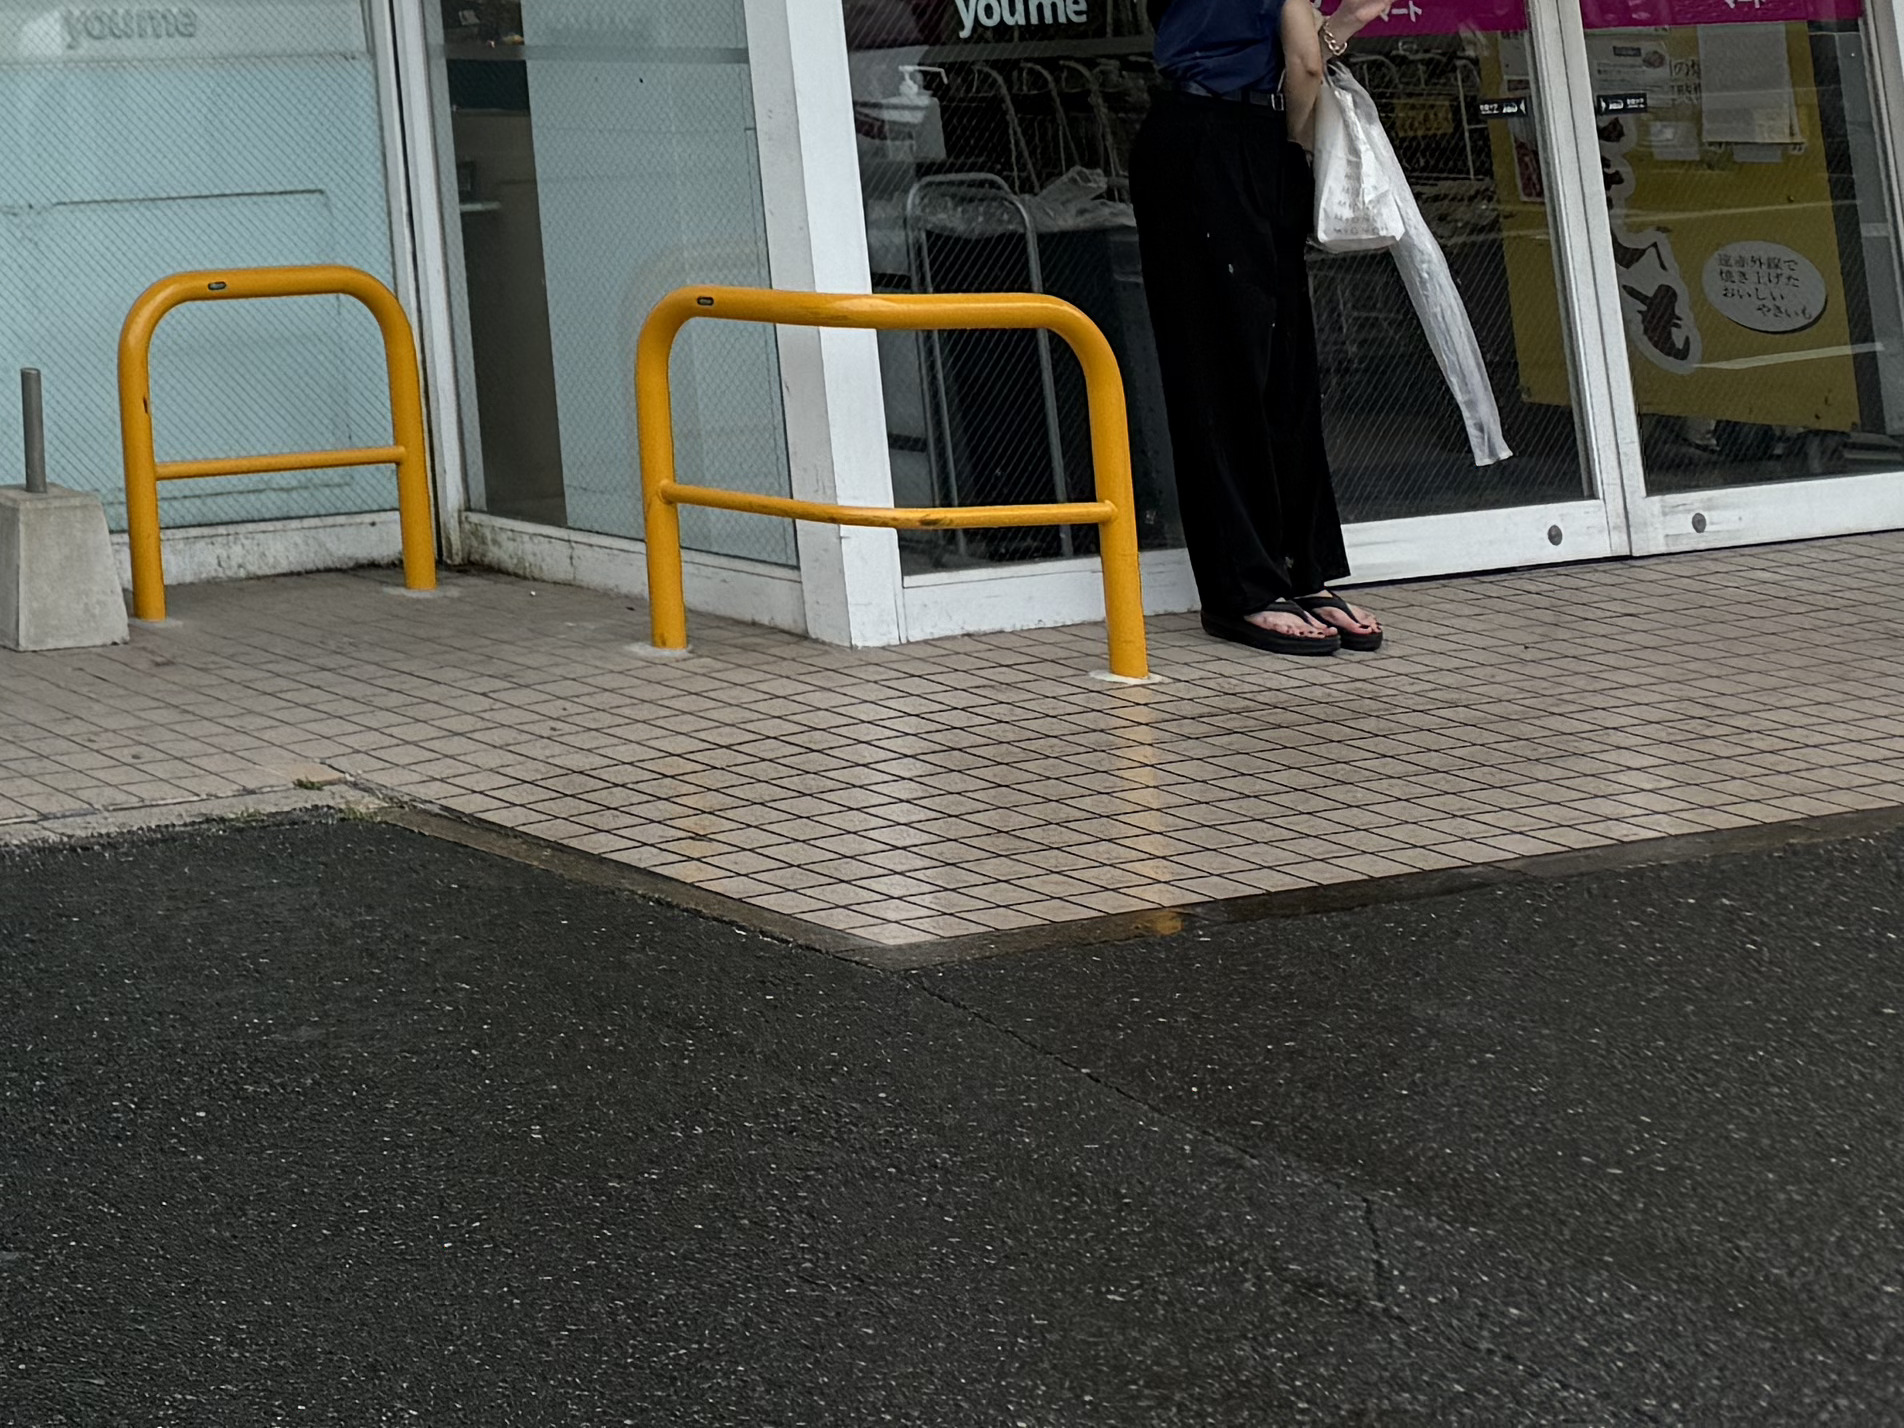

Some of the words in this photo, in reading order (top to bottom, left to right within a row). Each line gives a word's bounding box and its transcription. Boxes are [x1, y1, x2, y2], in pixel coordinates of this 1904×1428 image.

[65, 7, 198, 50] youme
[1722, 286, 1785, 302] おいしい
